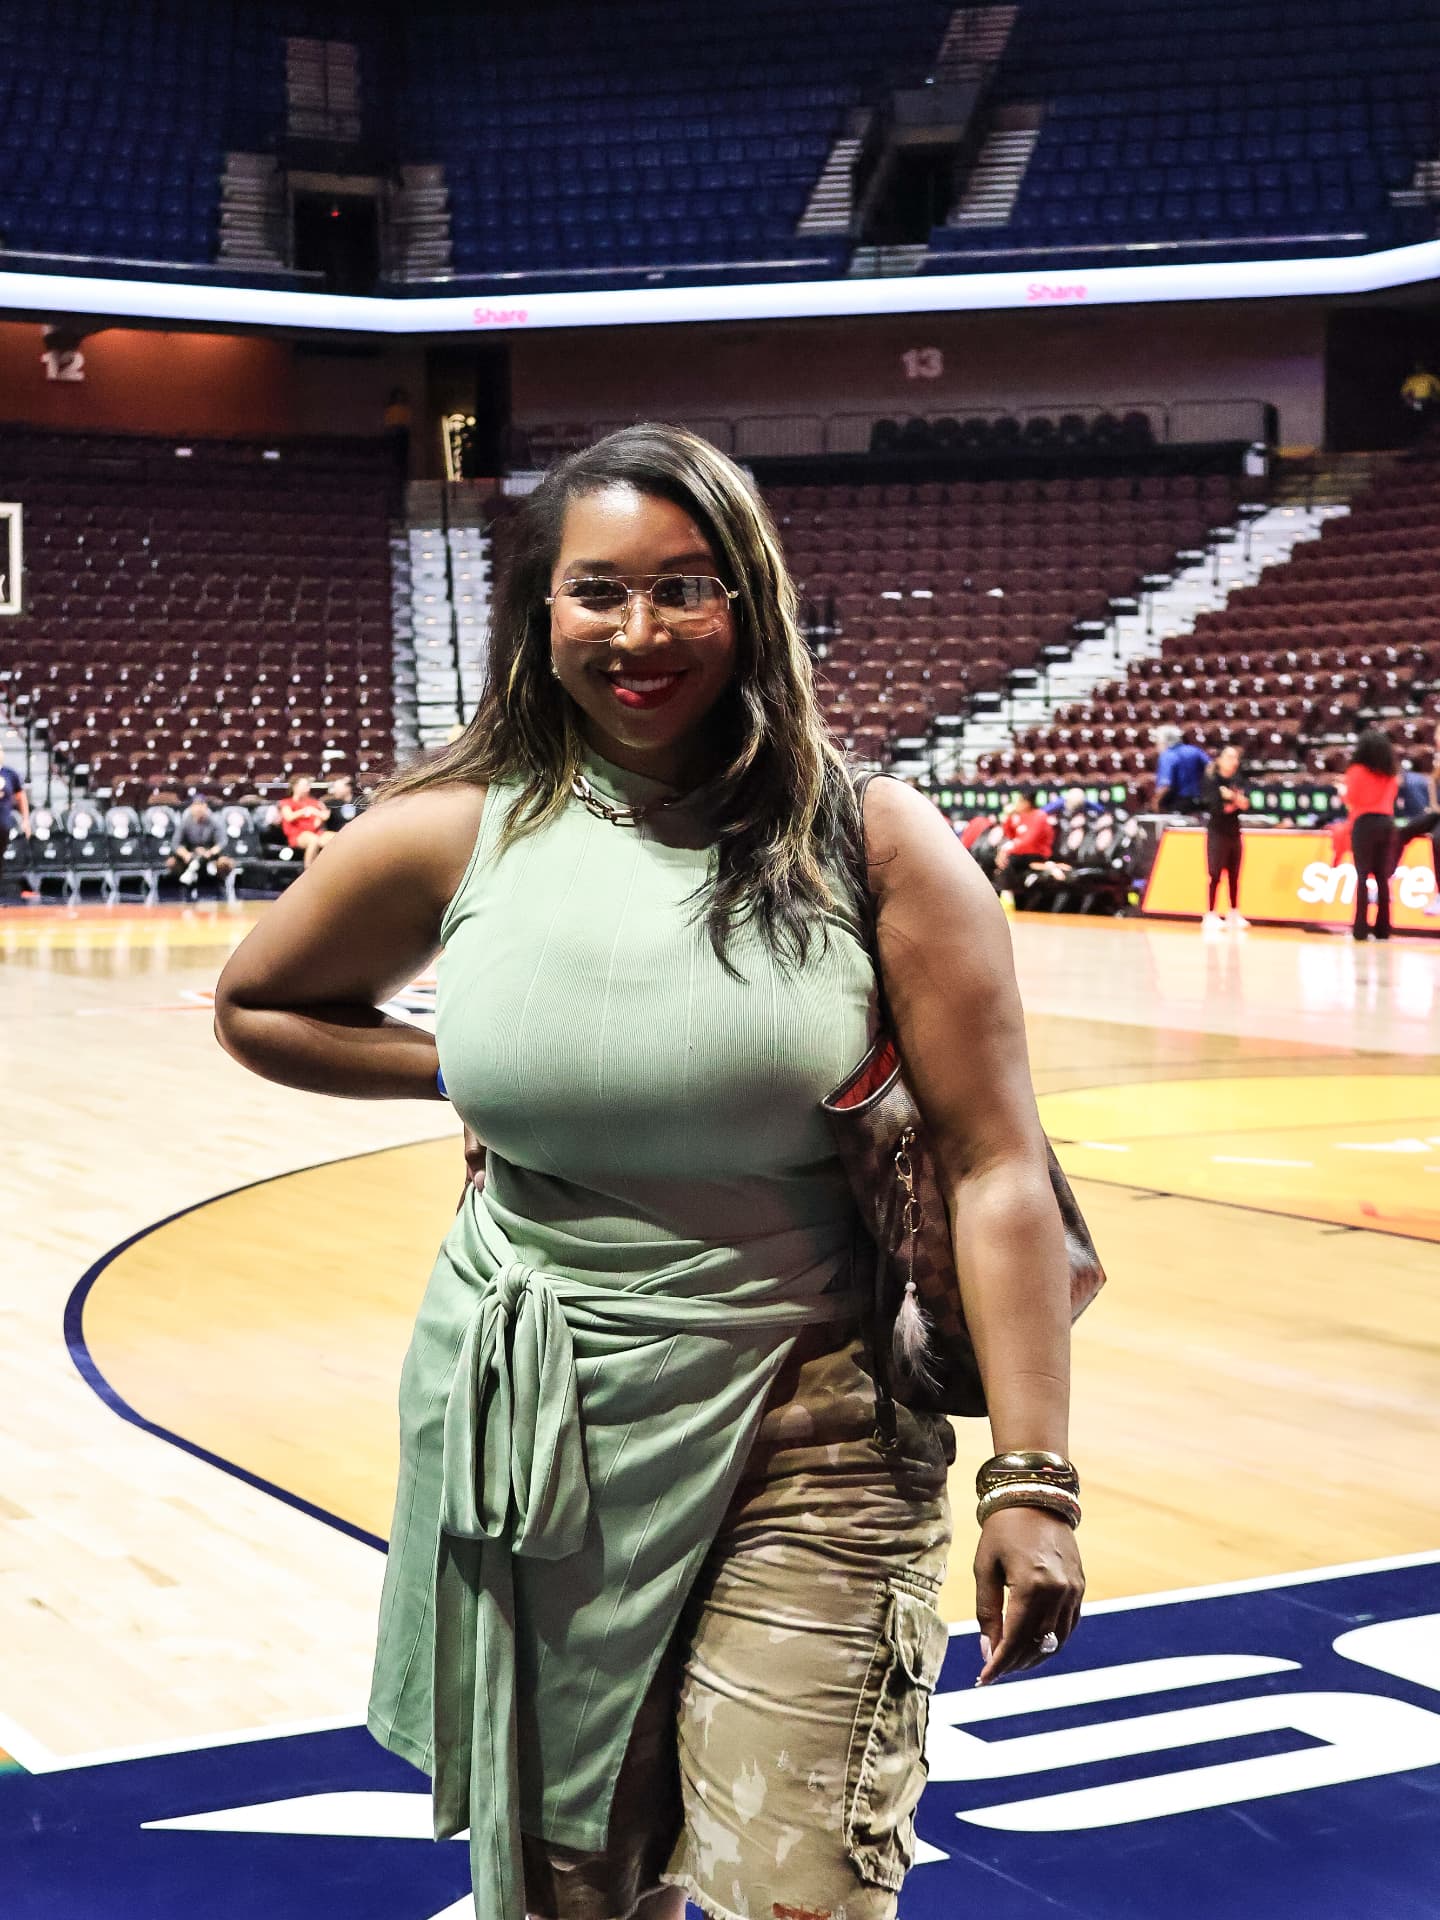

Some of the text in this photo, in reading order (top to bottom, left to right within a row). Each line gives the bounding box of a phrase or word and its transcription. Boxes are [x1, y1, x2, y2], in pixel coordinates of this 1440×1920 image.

[1026, 283, 1088, 302] Share
[473, 307, 528, 325] Share
[41, 351, 85, 381] 12
[902, 347, 944, 378] 13
